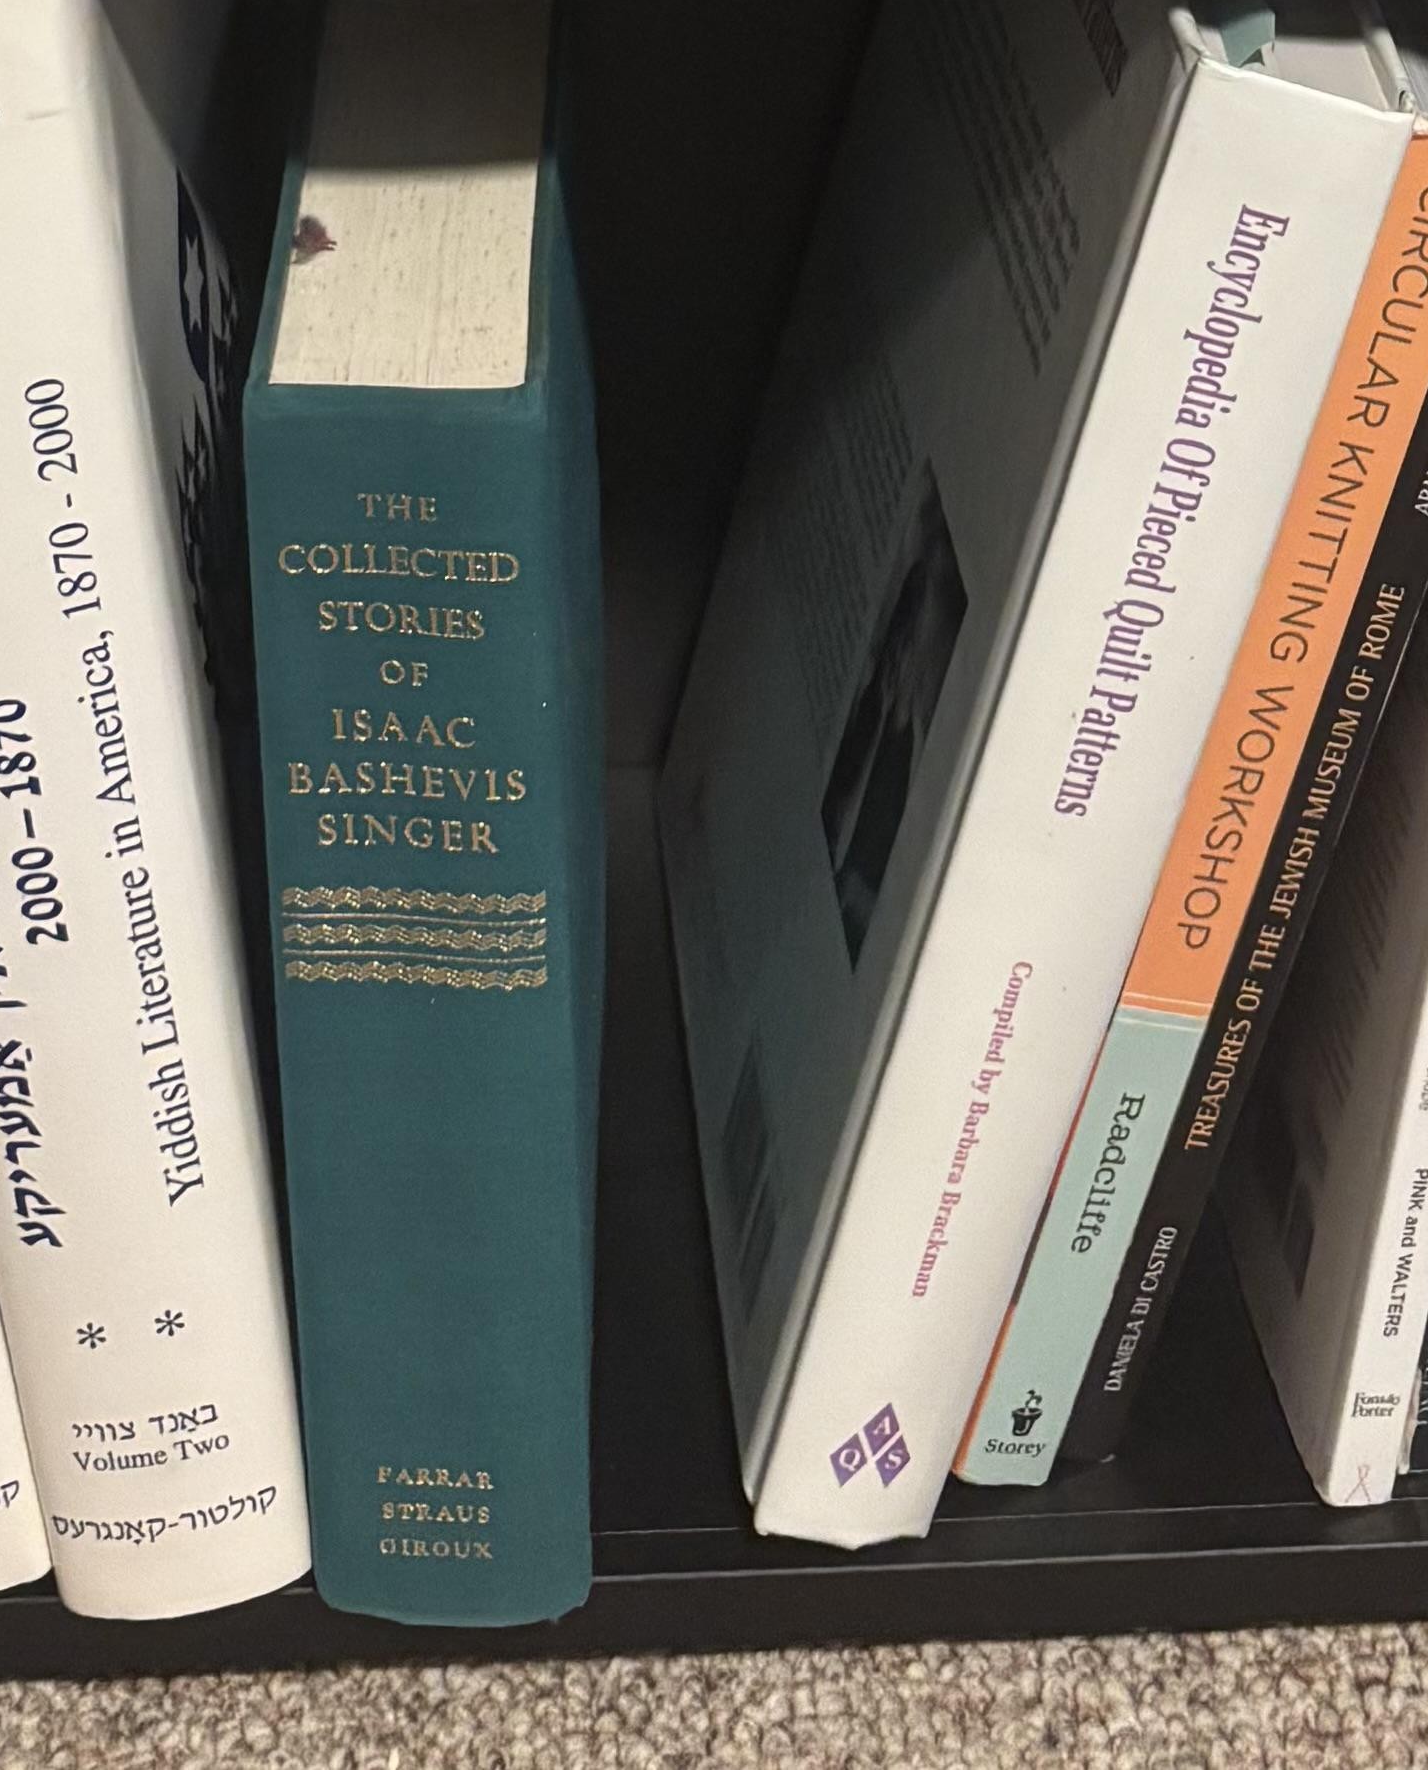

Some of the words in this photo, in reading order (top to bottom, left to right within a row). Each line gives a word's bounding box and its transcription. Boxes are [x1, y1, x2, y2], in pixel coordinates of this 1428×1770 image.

[1269, 439, 1375, 666] KNITTING
[288, 762, 527, 802] BASHEVIS
[1178, 684, 1295, 949] WORKSHOP
[1185, 1019, 1252, 1150] TREASURES
[1235, 975, 1265, 1010] OF
[1250, 919, 1285, 973] THE
[1269, 827, 1322, 919] JEWISH
[1309, 707, 1363, 820] MUSEUM
[1345, 665, 1377, 701] OF
[1363, 582, 1405, 660] ROME
[991, 960, 1032, 1064] Compiled
[971, 1060, 1005, 1096] by
[946, 1096, 990, 1187] Barbara
[1071, 1092, 1145, 1256] Radcliffe
[912, 1182, 962, 1299] Brackman
[74, 1449, 168, 1472] Volume
[173, 1432, 230, 1462] Two
[984, 1437, 1046, 1457] Storey
